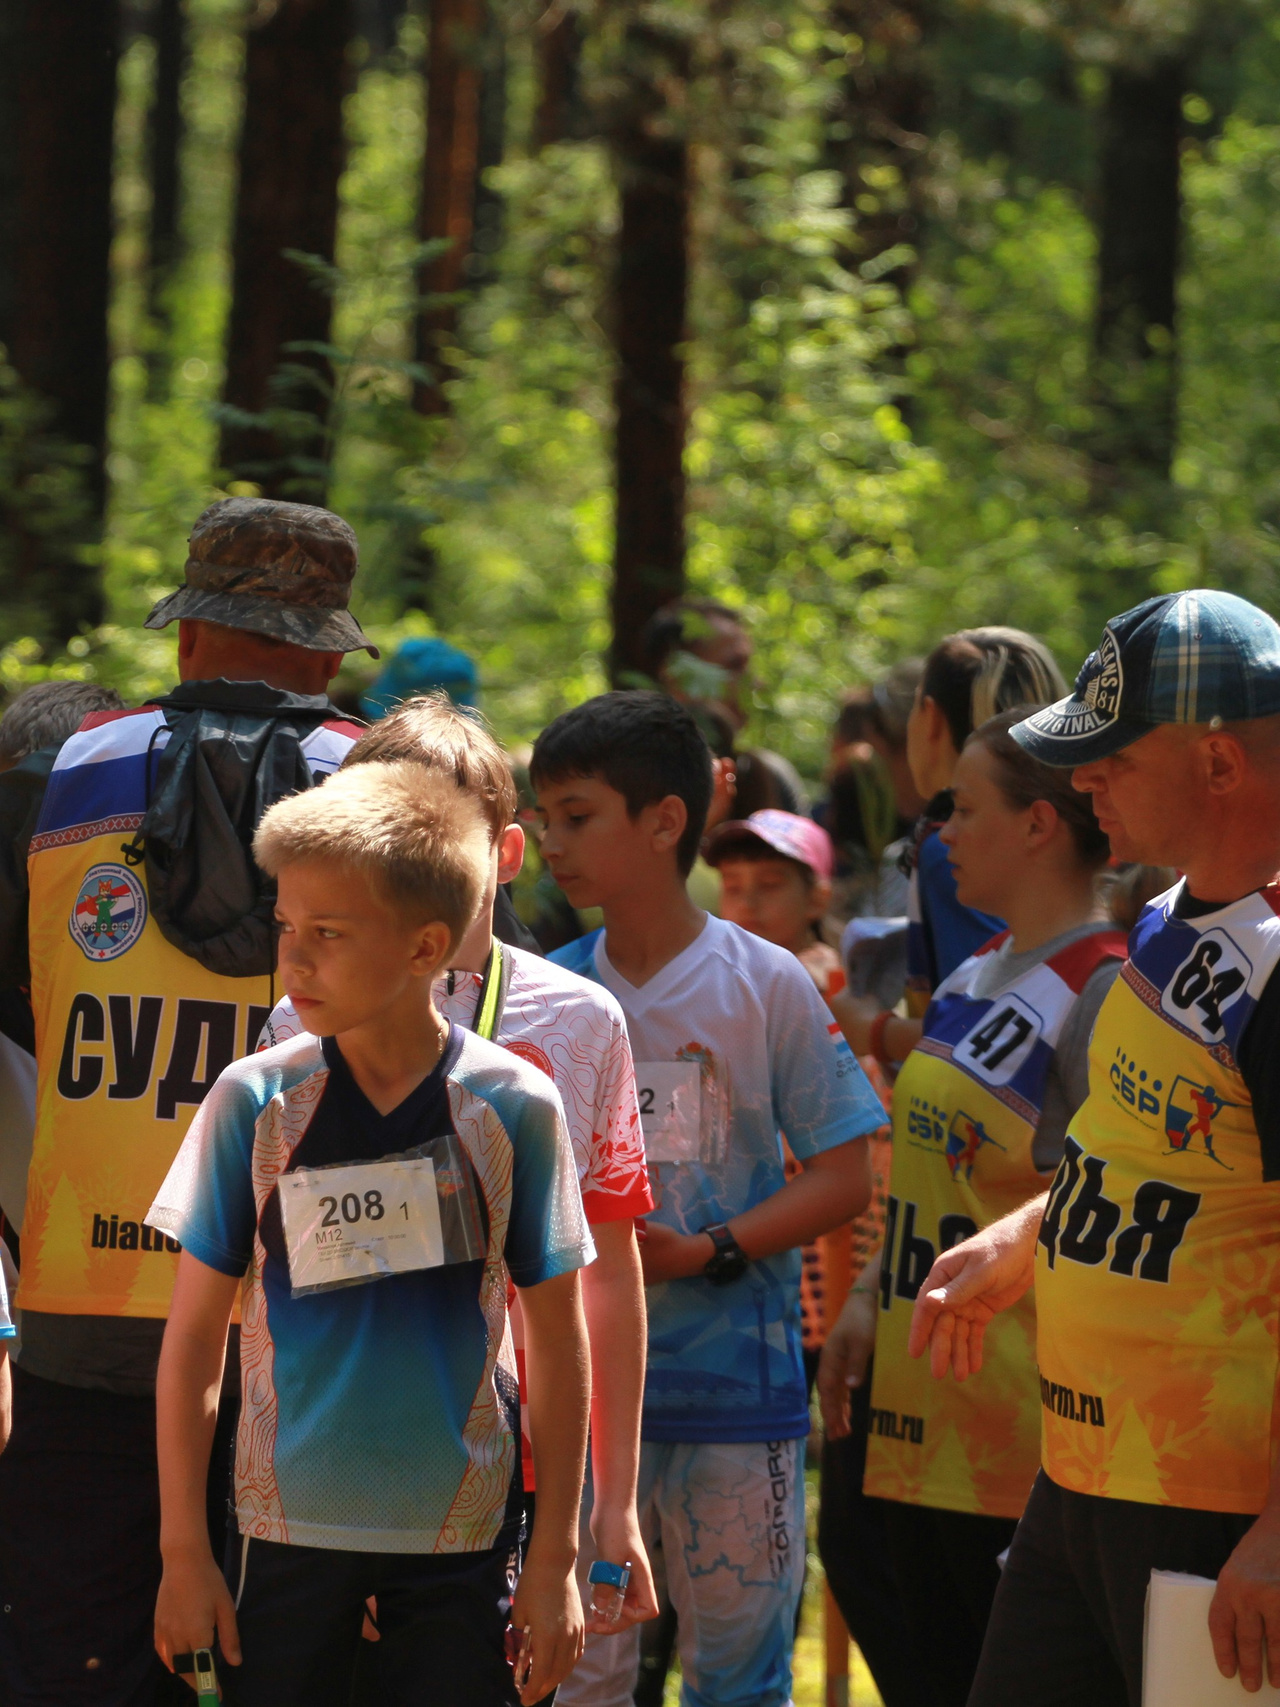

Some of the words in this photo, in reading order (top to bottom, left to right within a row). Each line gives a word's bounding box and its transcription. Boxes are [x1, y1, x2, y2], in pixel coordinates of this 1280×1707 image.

[1097, 690, 1116, 712] 81
[1170, 939, 1246, 1036] 64
[968, 1005, 1034, 1072] 47
[1109, 1062, 1160, 1116] СБР
[318, 1190, 385, 1227] 208
[399, 1201, 410, 1221] 1
